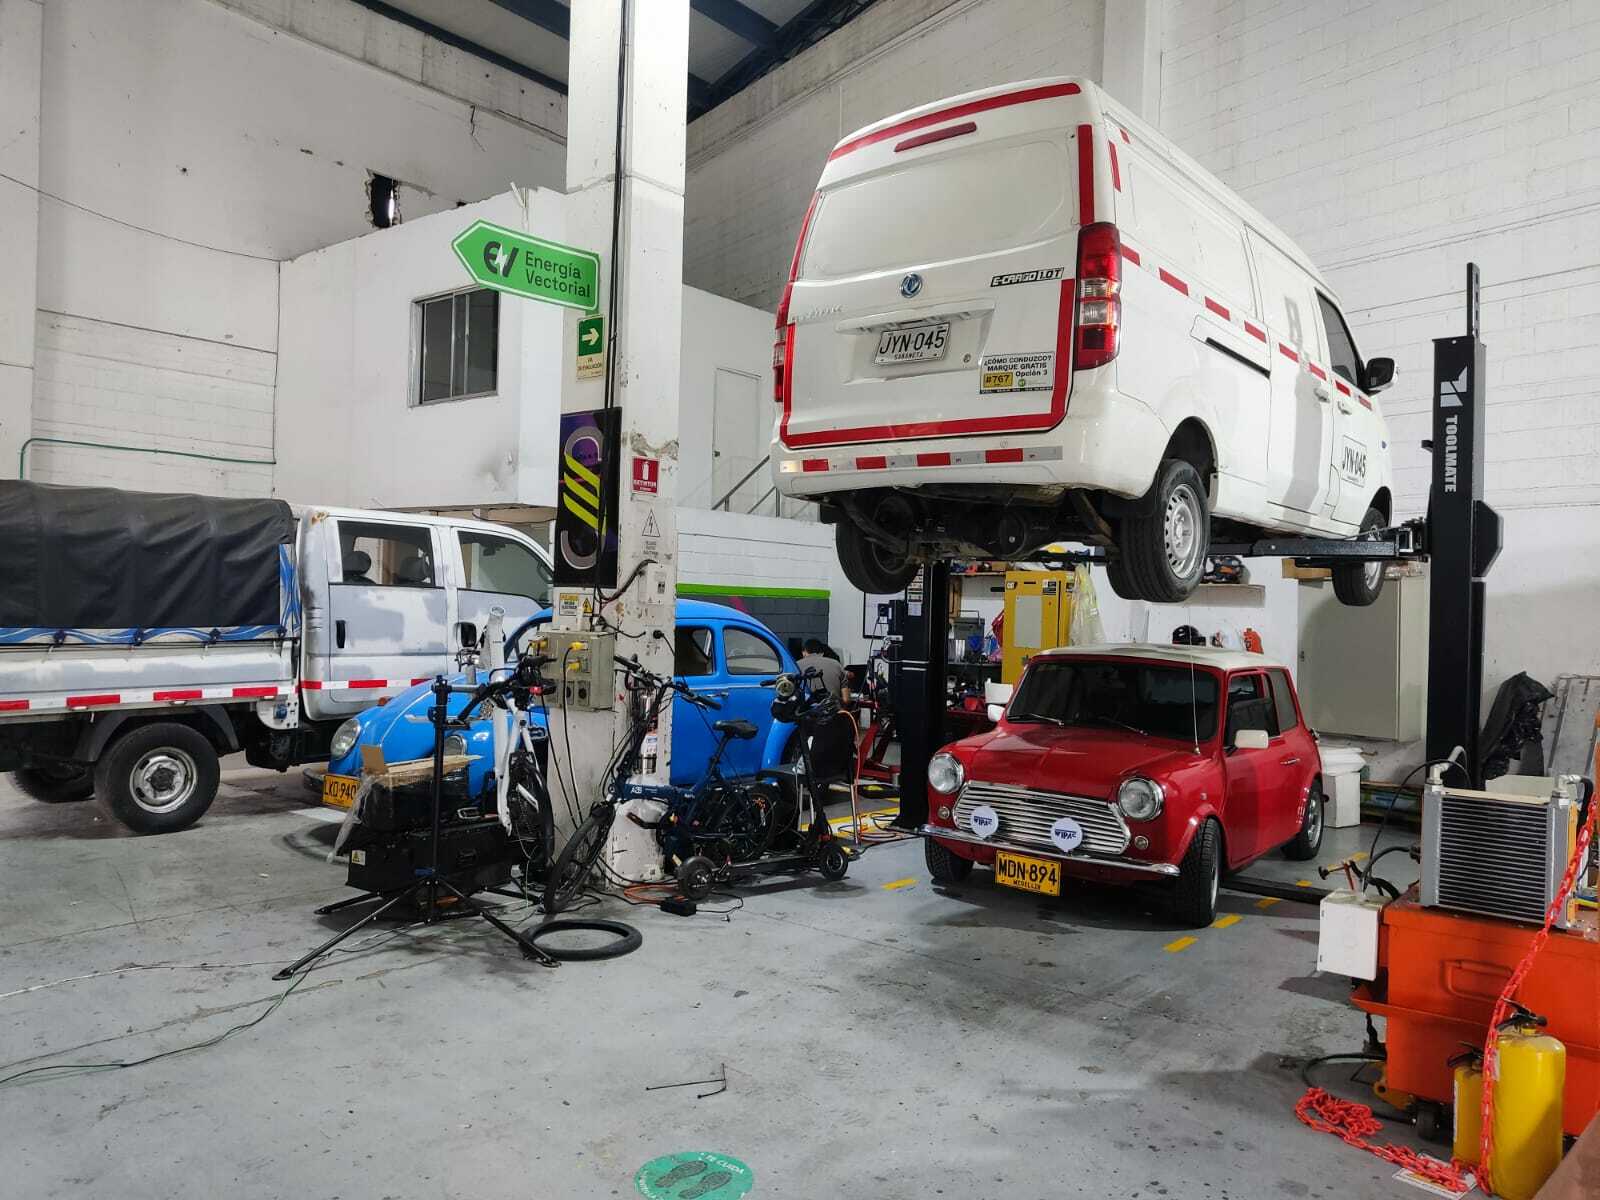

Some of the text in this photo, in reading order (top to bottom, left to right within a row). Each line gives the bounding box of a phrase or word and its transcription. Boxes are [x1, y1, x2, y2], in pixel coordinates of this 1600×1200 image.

[525, 251, 582, 280] Energía
[526, 269, 591, 298] Vectorial
[987, 362, 1047, 372] MARQUE GRATIS
[1015, 369, 1041, 378] Opción
[986, 374, 1010, 384] #767
[1445, 414, 1458, 493] TOOLMATE
